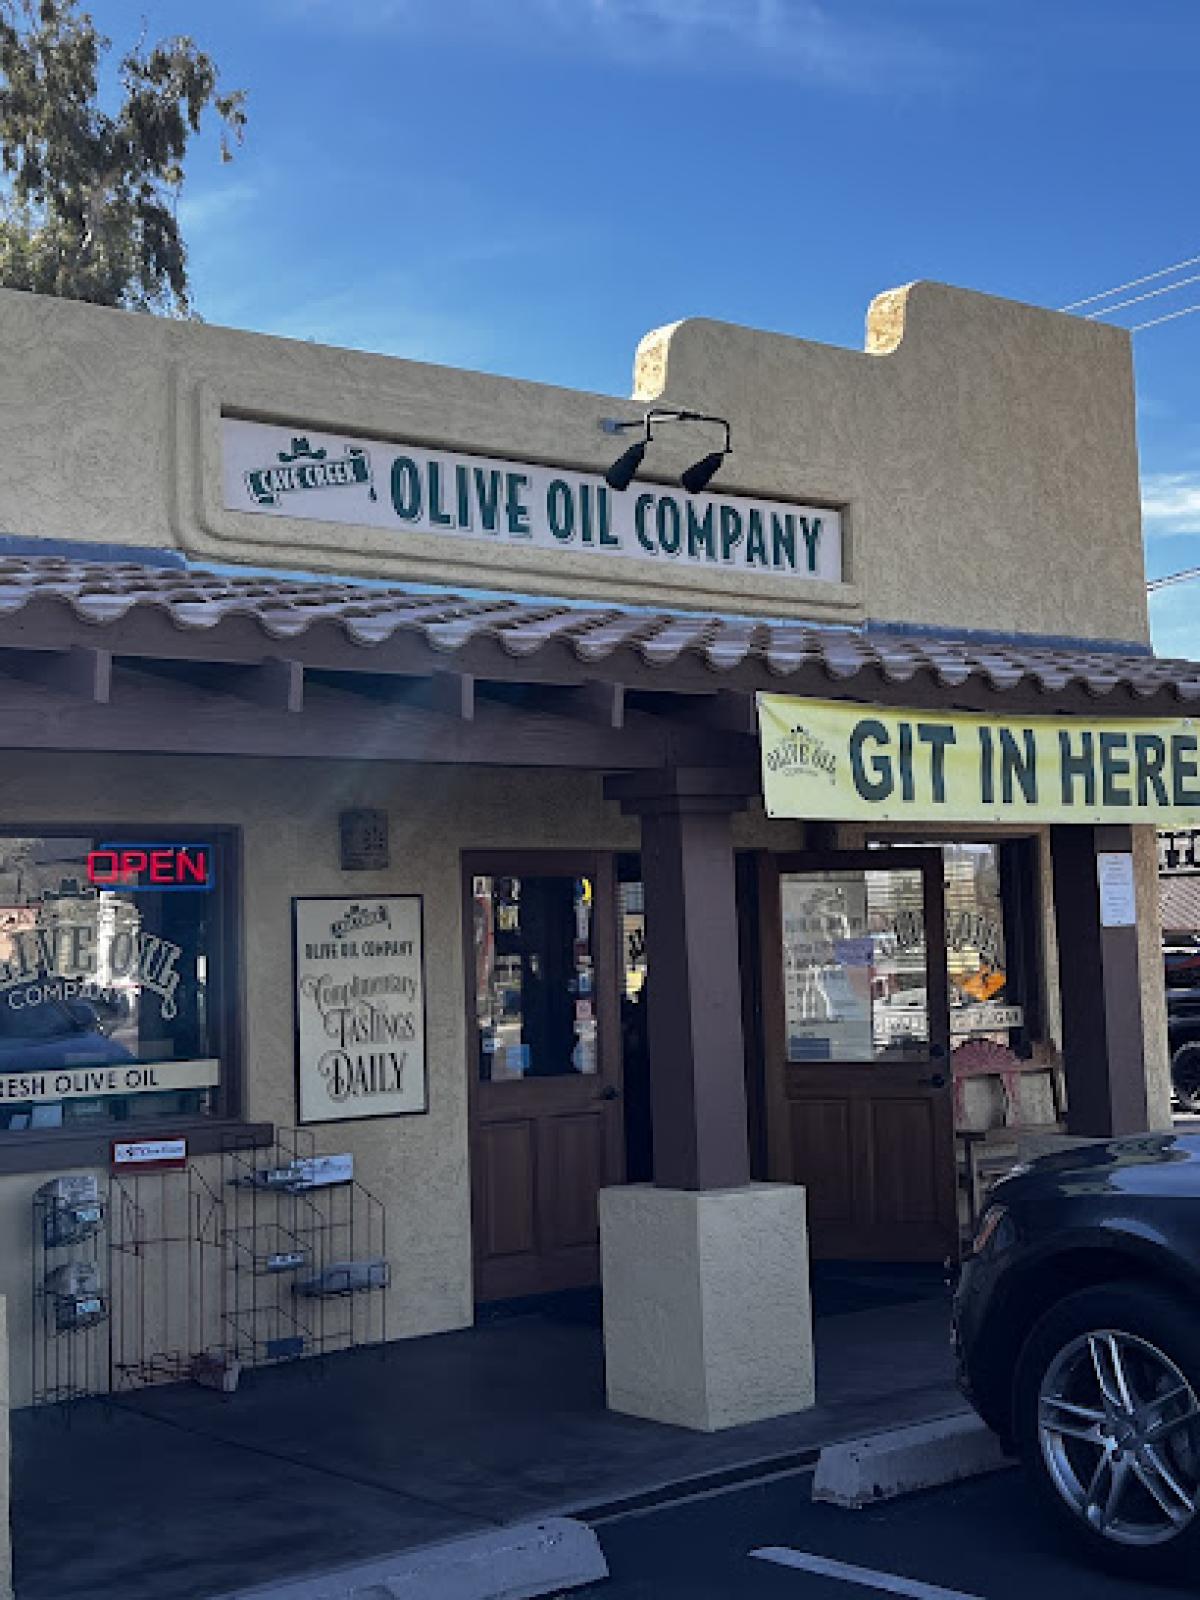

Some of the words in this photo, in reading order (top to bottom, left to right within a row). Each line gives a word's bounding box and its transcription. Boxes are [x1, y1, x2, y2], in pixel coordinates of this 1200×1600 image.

[391, 456, 530, 535] OLIVE
[547, 479, 620, 546] OIL
[635, 494, 822, 573] COMPANY
[850, 719, 957, 803] GIT
[980, 726, 1039, 804] IN
[1059, 730, 1200, 807] HERE
[88, 850, 207, 882] OPEN
[305, 943, 339, 960] OLIVE
[361, 940, 414, 957] COMPANY
[55, 1070, 117, 1094] OLIVE
[126, 1069, 160, 1088] OIL
